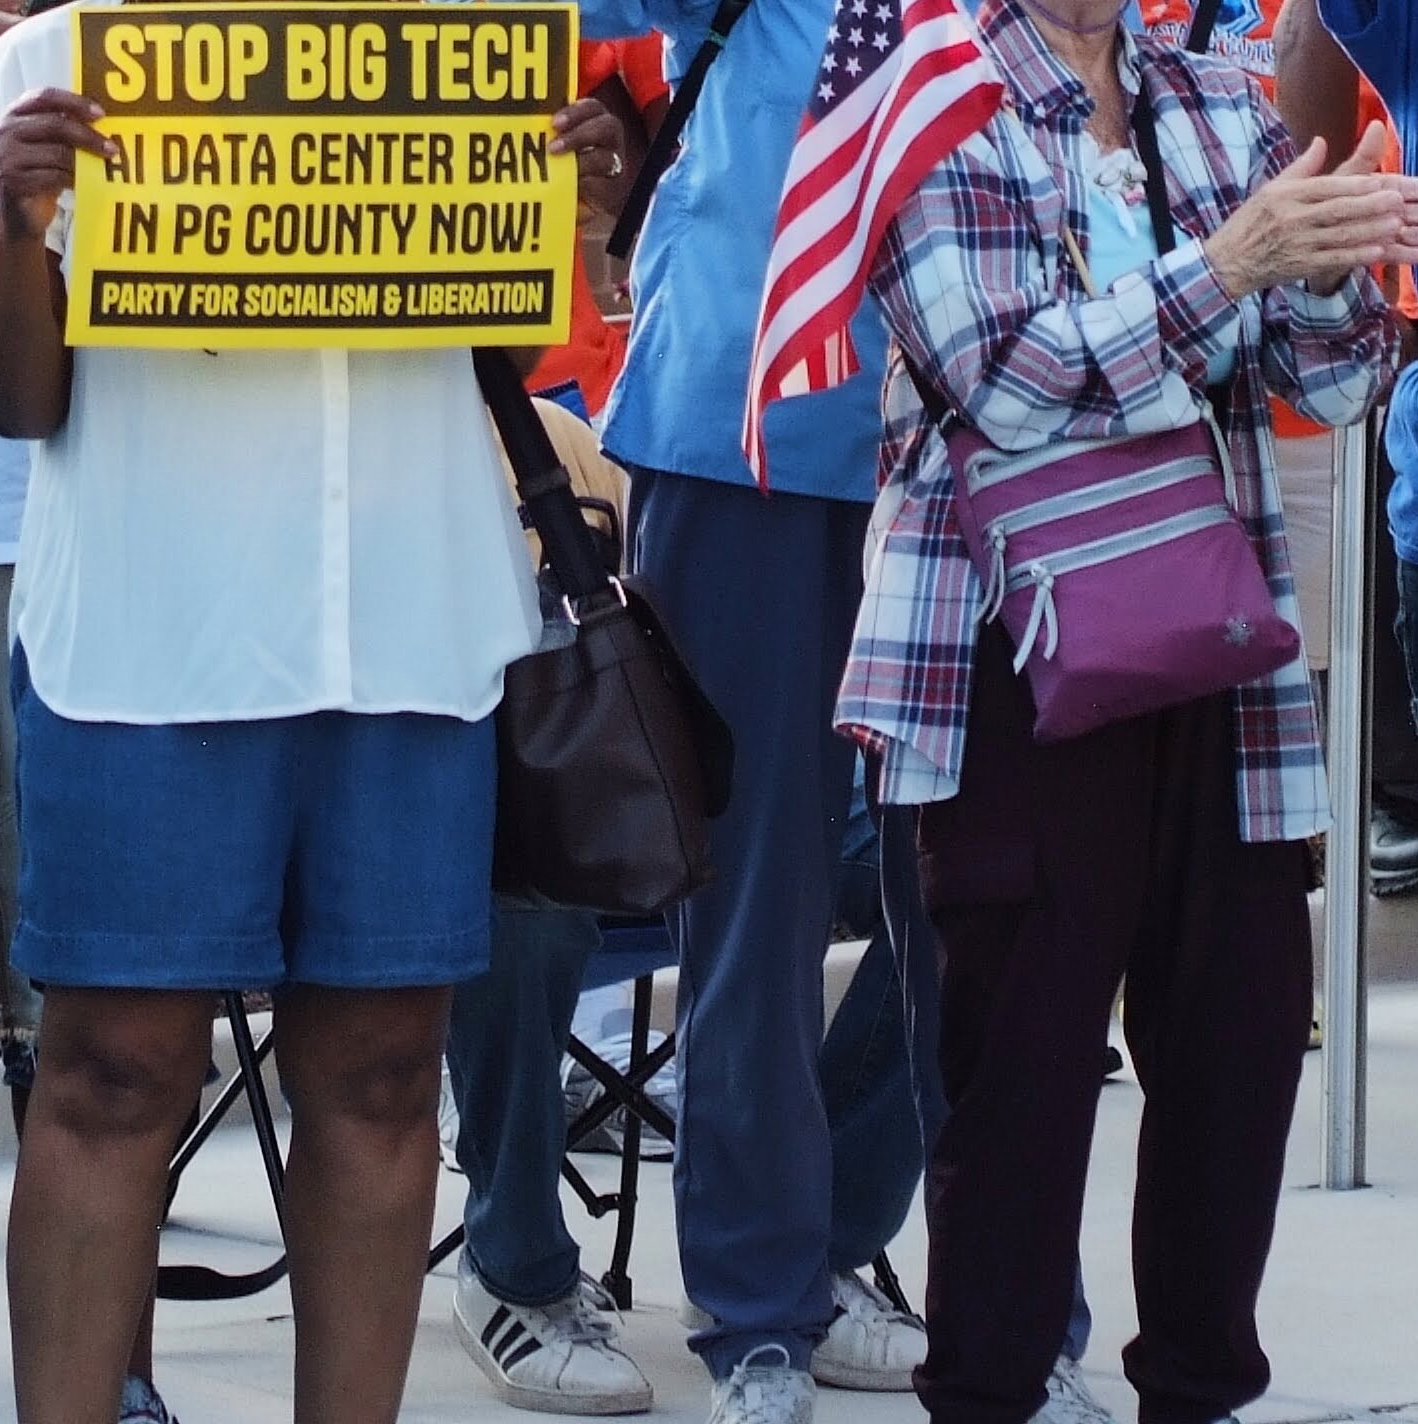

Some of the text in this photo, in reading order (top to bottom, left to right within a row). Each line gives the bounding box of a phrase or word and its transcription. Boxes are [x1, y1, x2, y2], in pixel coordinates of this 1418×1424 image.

[104, 23, 549, 103] STOP BIG TECH
[106, 131, 549, 186] AI DATA CENTER BAN
[112, 201, 543, 256] IN PG COUNTY NOW!
[101, 281, 544, 318] PARTY FOR SOCIALISM & LIBERATION
